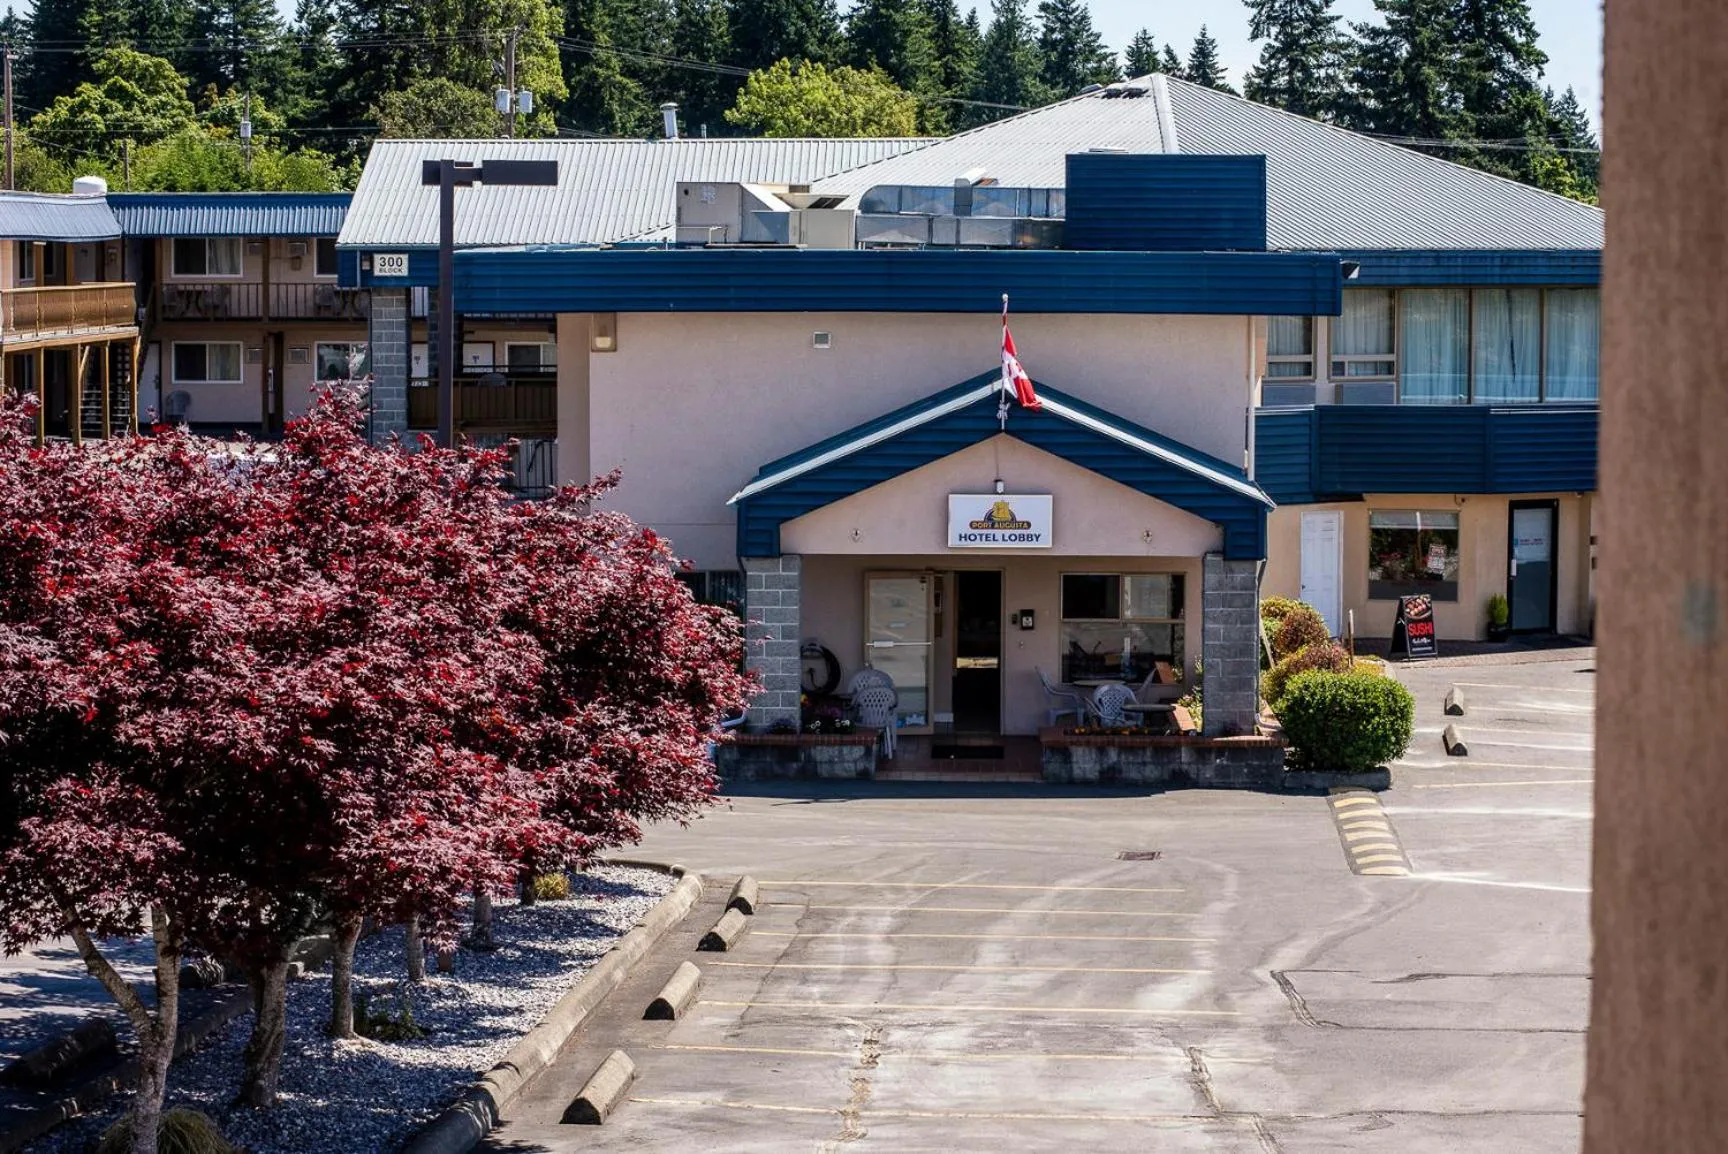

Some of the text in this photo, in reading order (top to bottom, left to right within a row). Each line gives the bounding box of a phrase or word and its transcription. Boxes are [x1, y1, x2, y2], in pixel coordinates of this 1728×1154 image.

[379, 256, 403, 267] 300
[958, 533, 1042, 542] HOTEL LOBBY
[1408, 622, 1434, 636] SUSHI
